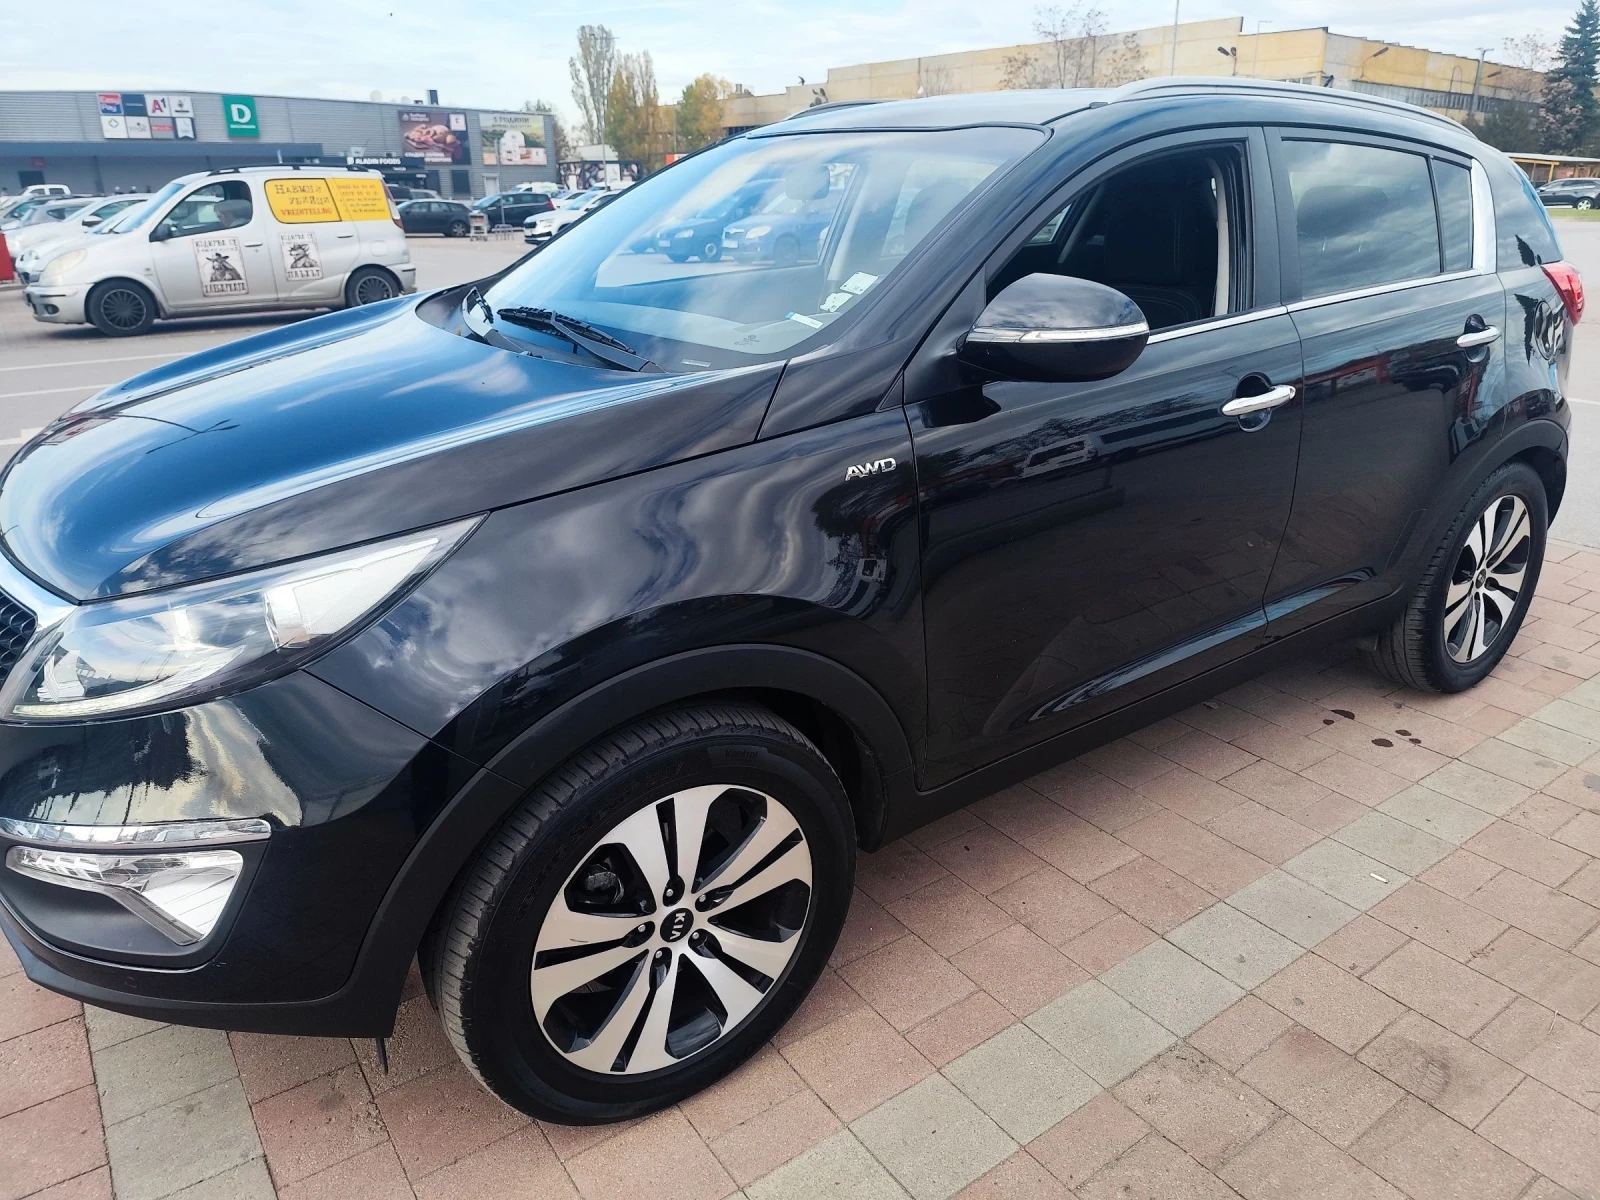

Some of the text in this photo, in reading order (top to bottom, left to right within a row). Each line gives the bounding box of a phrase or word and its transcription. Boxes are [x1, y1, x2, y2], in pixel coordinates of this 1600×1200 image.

[152, 98, 167, 113] A1
[231, 104, 252, 123] D
[845, 457, 897, 482] AWD
[669, 912, 686, 940] KIA
